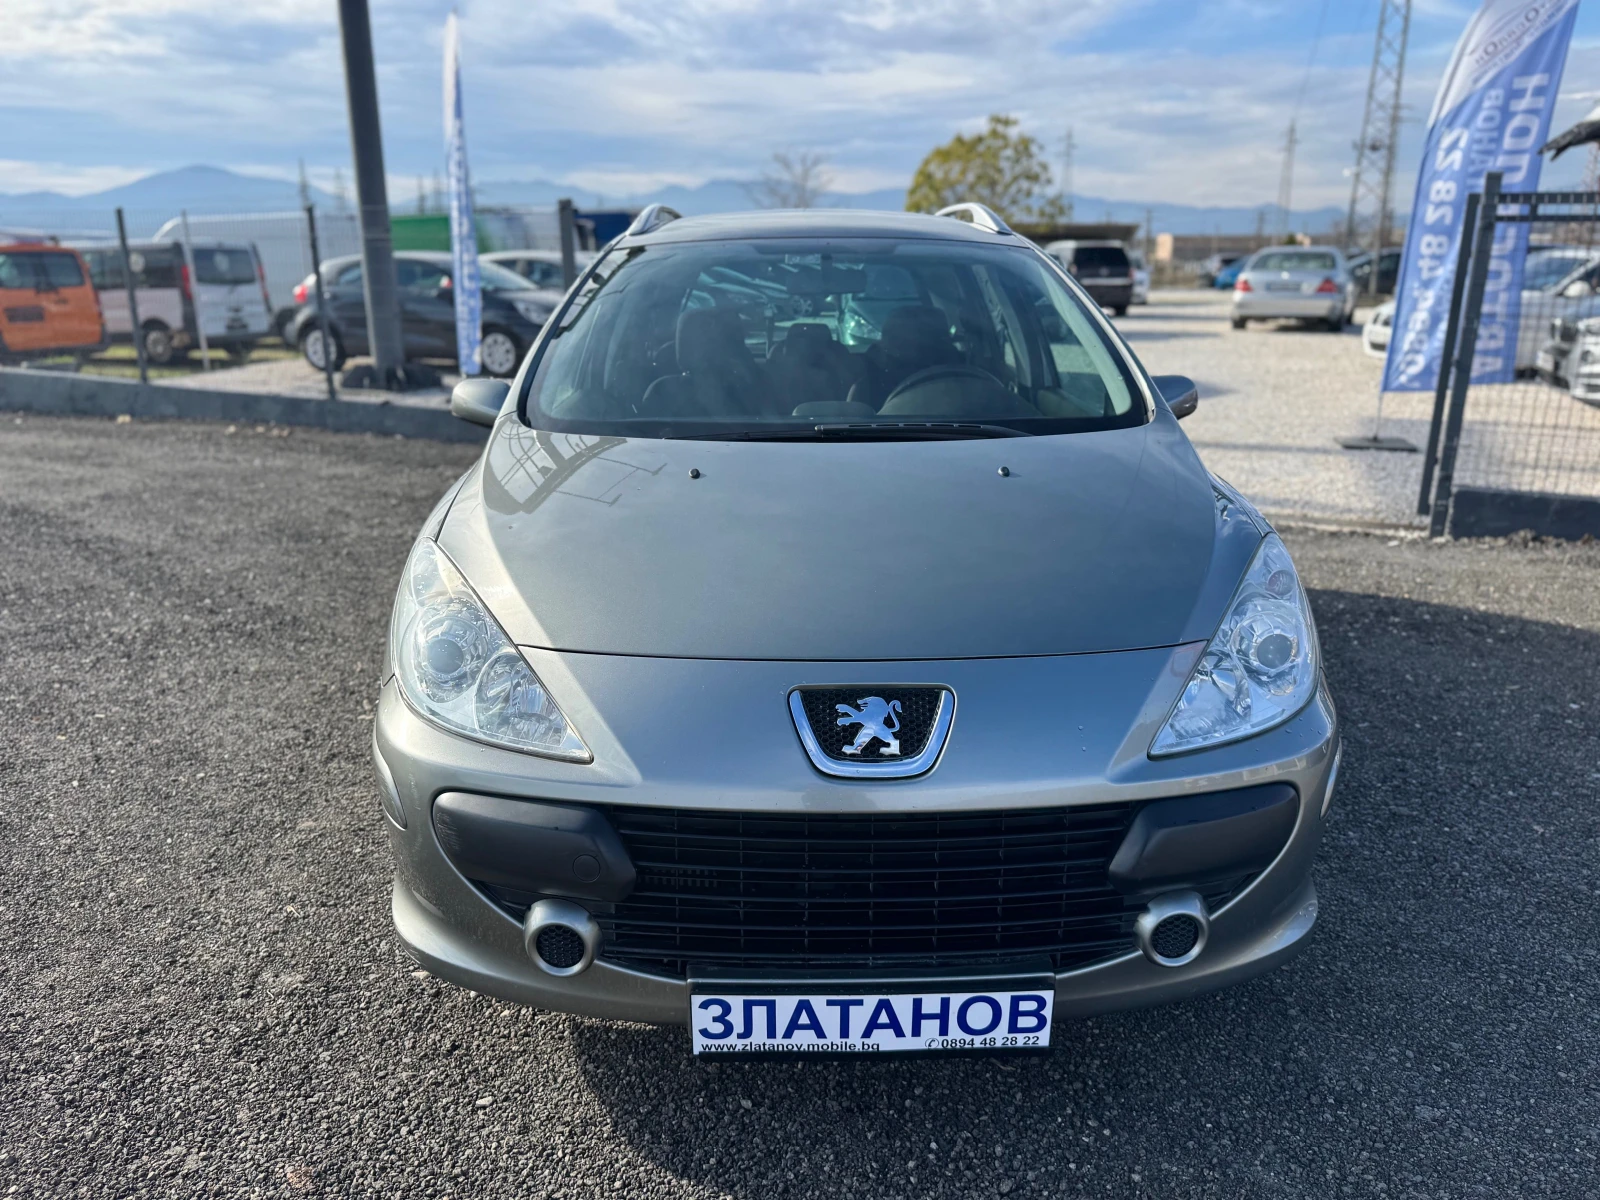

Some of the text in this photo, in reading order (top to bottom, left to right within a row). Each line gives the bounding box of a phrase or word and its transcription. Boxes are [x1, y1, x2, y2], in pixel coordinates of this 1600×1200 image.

[698, 994, 1048, 1040] ЗЛАТАНОВ
[700, 1040, 880, 1051] www.zlatanov.mobile.bg
[941, 1035, 1040, 1048] 0894 48 28 22
